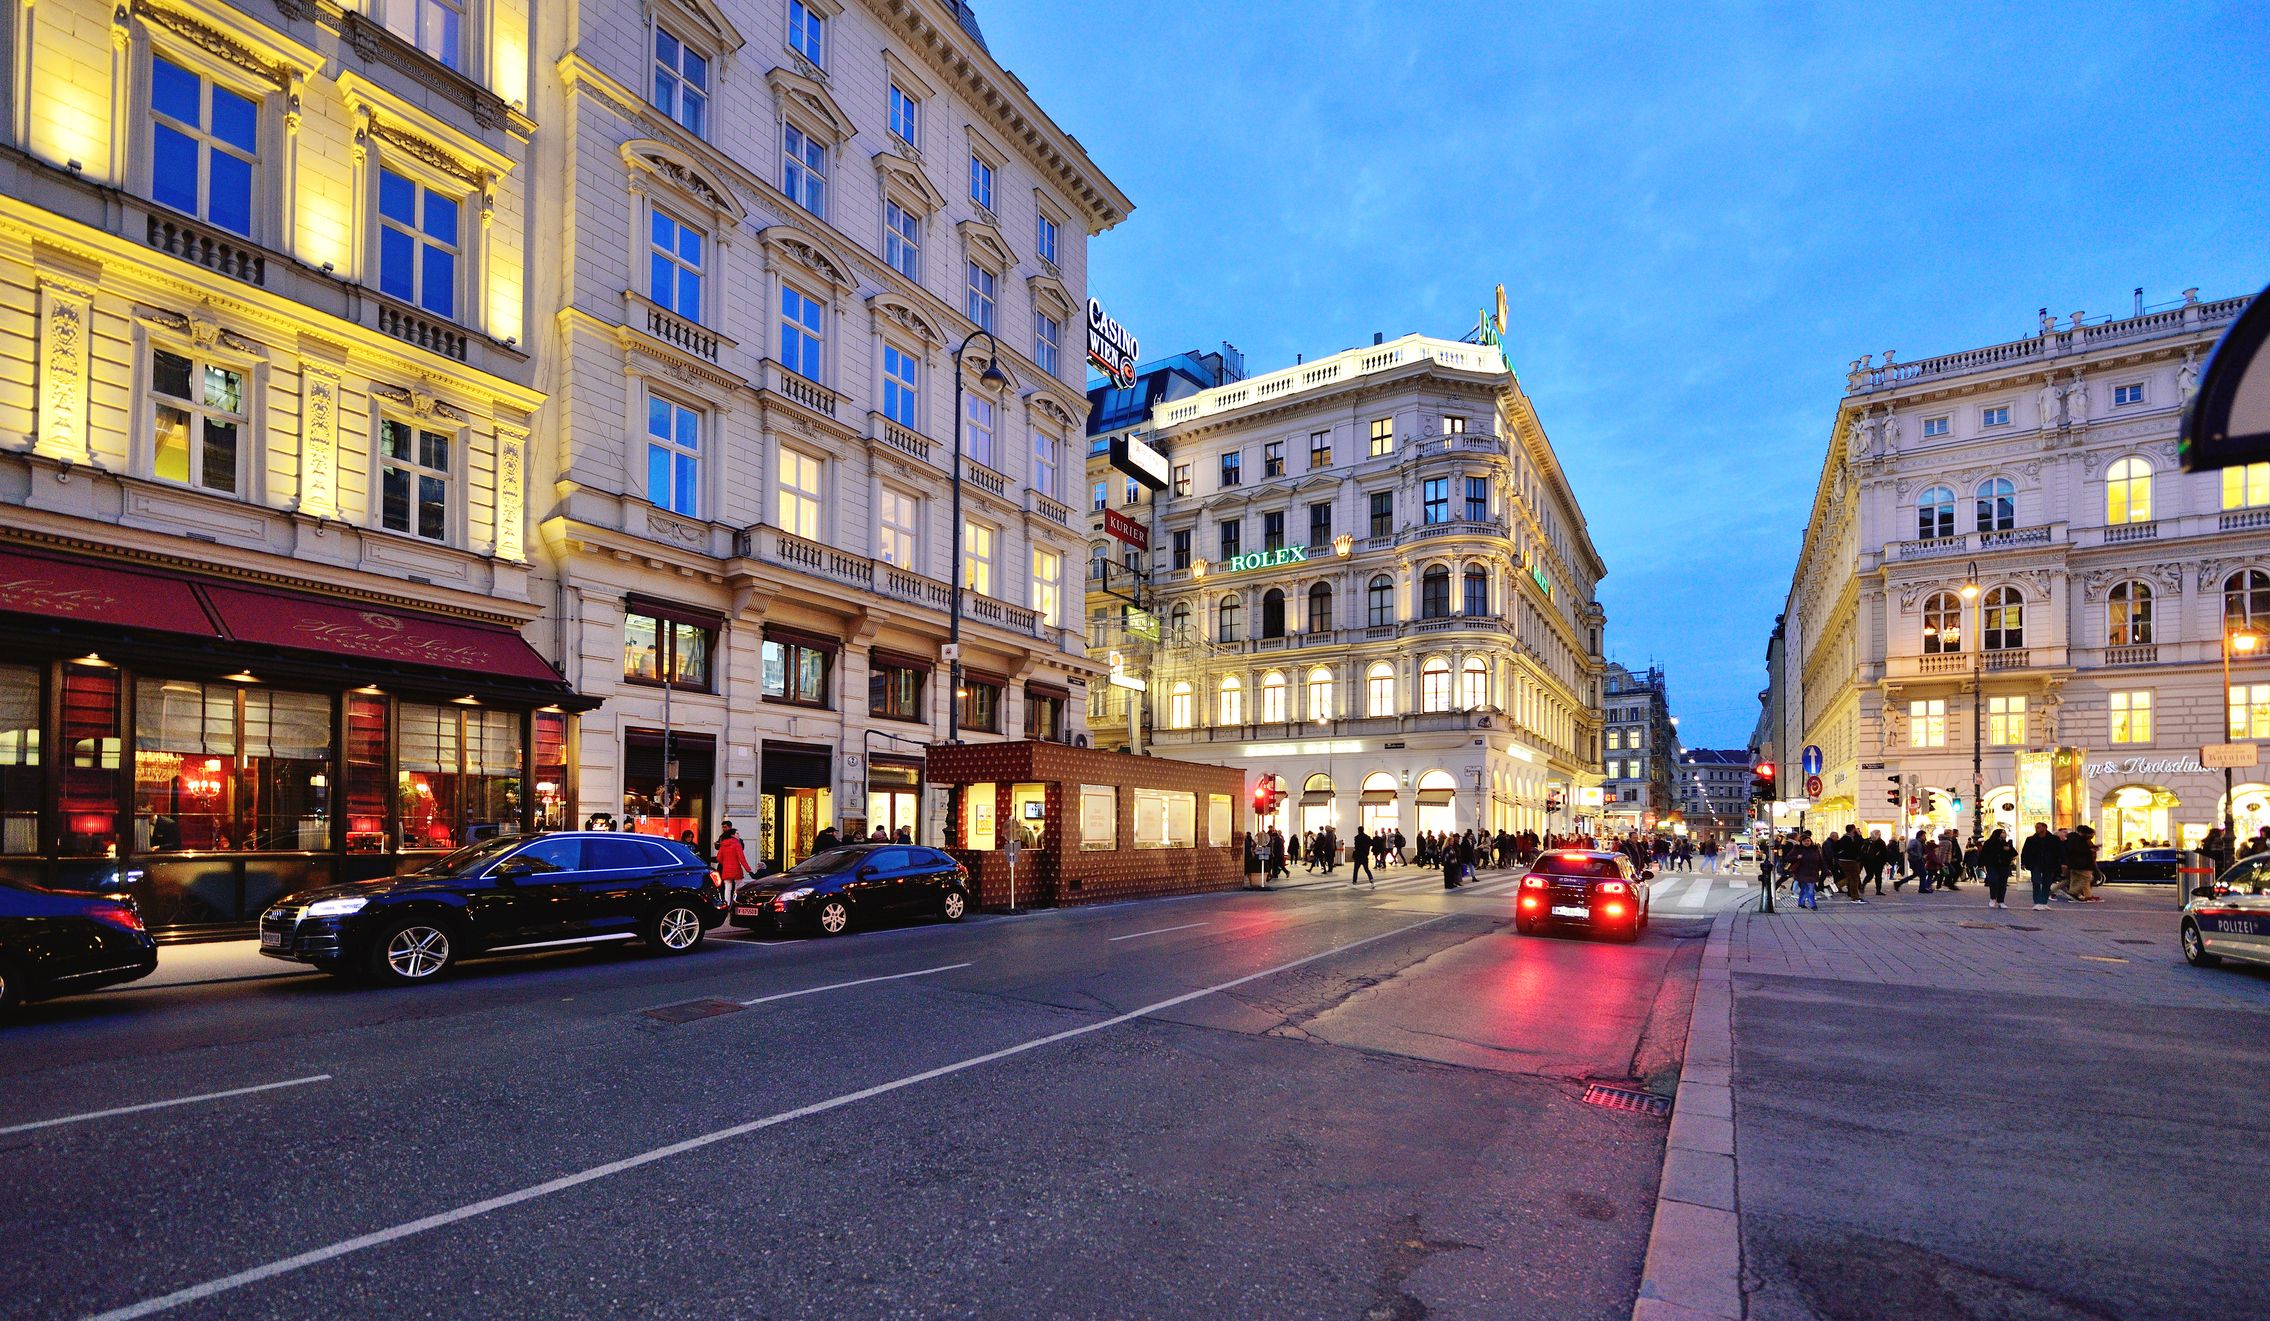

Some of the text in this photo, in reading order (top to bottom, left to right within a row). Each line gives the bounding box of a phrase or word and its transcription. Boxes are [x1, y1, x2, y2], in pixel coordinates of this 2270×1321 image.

[1089, 297, 1139, 362] CASINO
[1089, 328, 1119, 369] WIEN
[1110, 516, 1145, 543] KURIER
[1230, 546, 1307, 572] ROLEX
[293, 618, 403, 642] Hotel
[2122, 755, 2219, 774] Kretschm
[2217, 919, 2254, 935] POLIZEI
